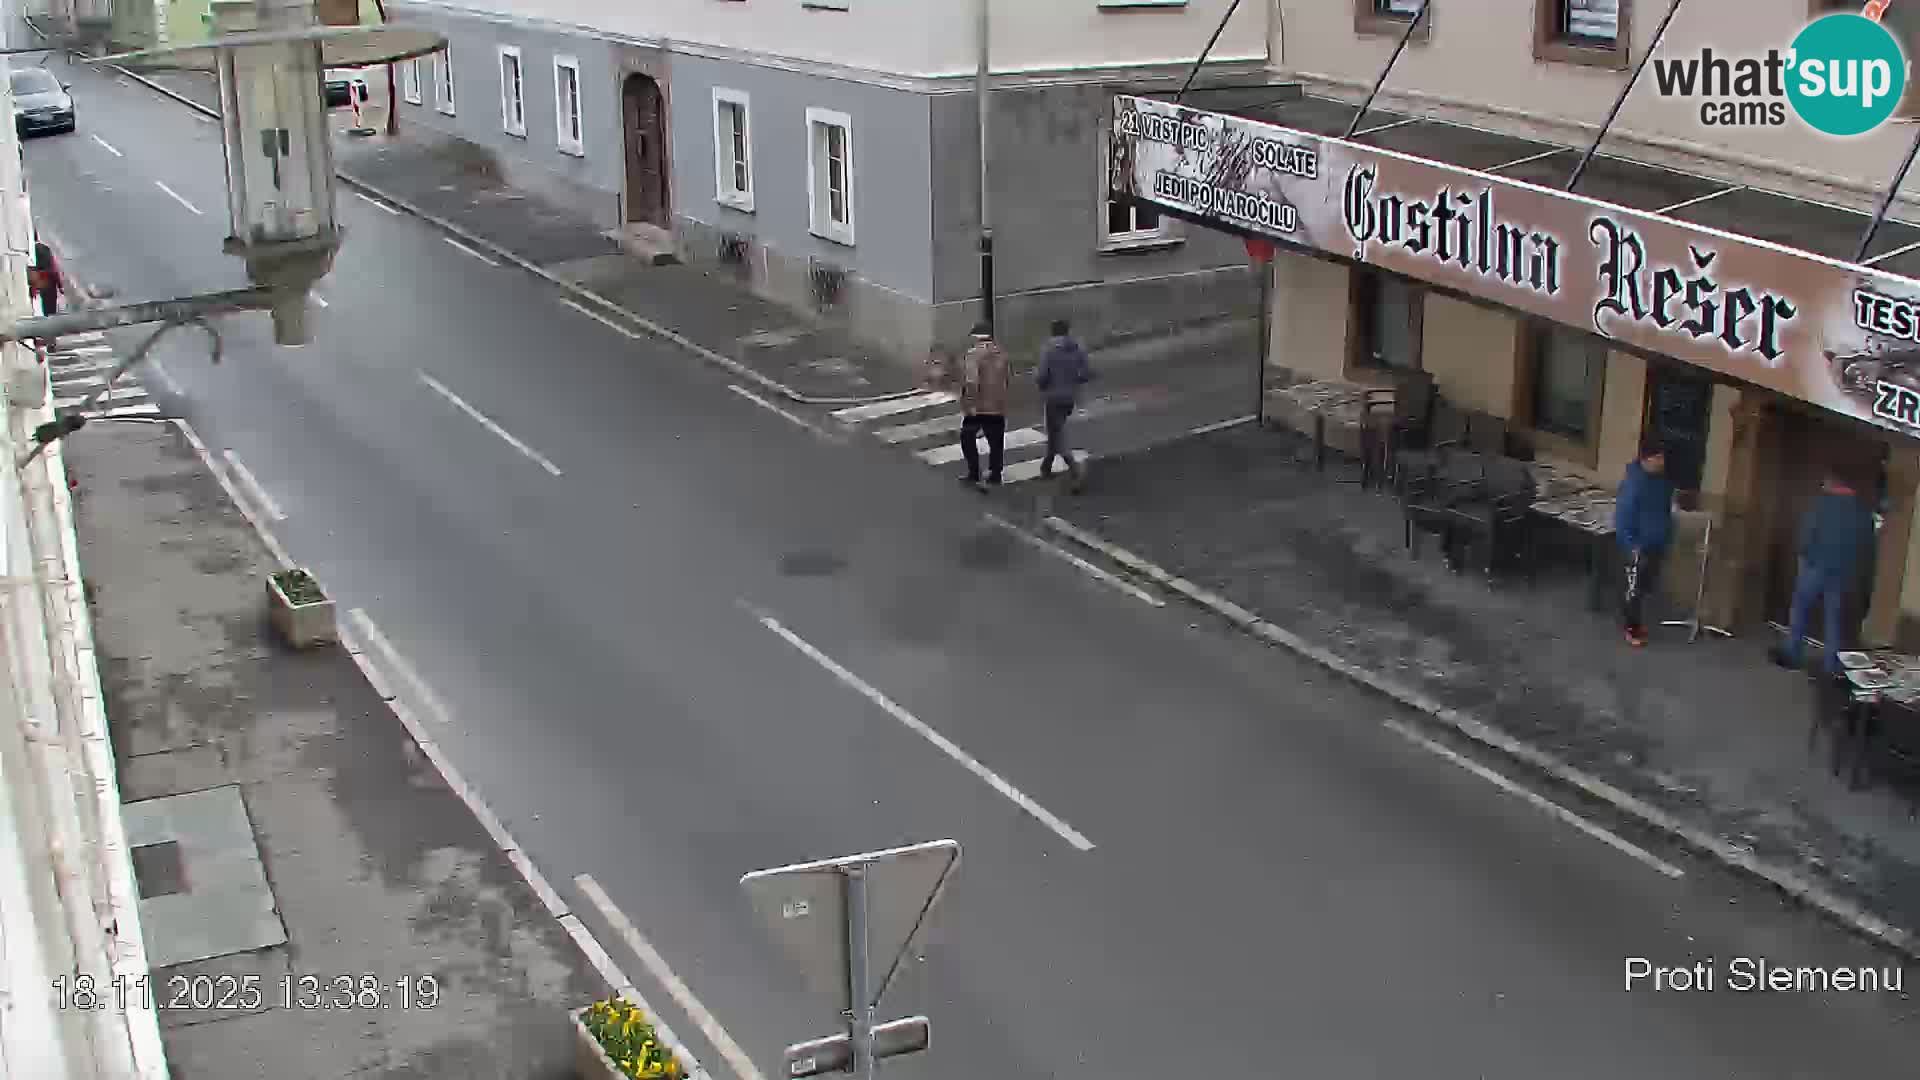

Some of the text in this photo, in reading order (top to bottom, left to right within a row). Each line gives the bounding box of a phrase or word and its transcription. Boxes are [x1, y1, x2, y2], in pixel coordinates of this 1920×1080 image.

[1142, 112, 1180, 144] VRST
[1181, 122, 1209, 150] PIC
[1253, 138, 1317, 177] SOLATE
[1155, 172, 1296, 232] JEDI PO NAROČILU
[1343, 161, 1798, 363] Gostilna Rešer
